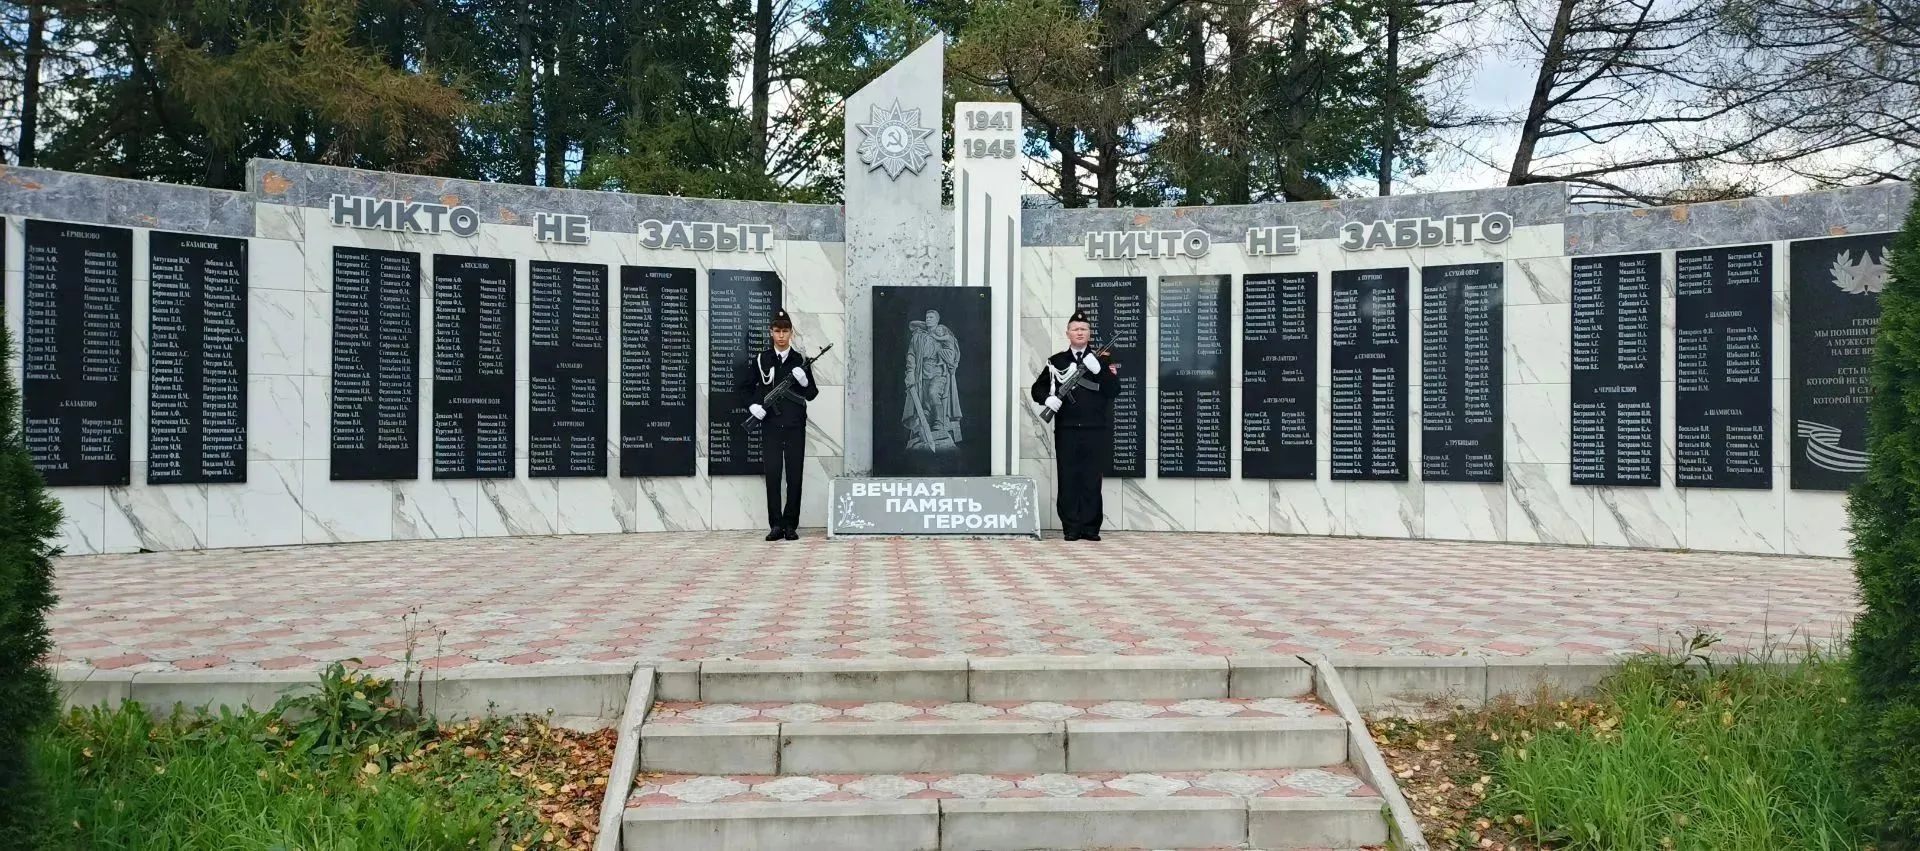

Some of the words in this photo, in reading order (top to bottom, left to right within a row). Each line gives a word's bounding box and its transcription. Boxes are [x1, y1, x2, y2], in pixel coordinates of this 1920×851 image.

[965, 110, 1014, 130] 1941
[963, 138, 1016, 159] 1945
[334, 196, 479, 236] НИКТО
[537, 214, 590, 242] НЕ
[642, 222, 770, 252] ЗАБЫТ
[1087, 230, 1209, 257] НИЧТО
[1249, 228, 1299, 253] НЕ
[1342, 213, 1512, 249] ЗАБЫТО
[186, 241, 218, 249] КАЗАНСКОЕ
[1831, 328, 1868, 336] ПОМНИМ
[1835, 338, 1877, 346] МУЖЕСТВ
[1807, 377, 1844, 385] КОТОРОЙ
[1814, 396, 1850, 404] КОТОРОЙ
[852, 483, 946, 496] ВЕЧНАЯ
[886, 499, 982, 512] ПАМЯТЬ
[923, 515, 1018, 528] ГЕРОЯМ
